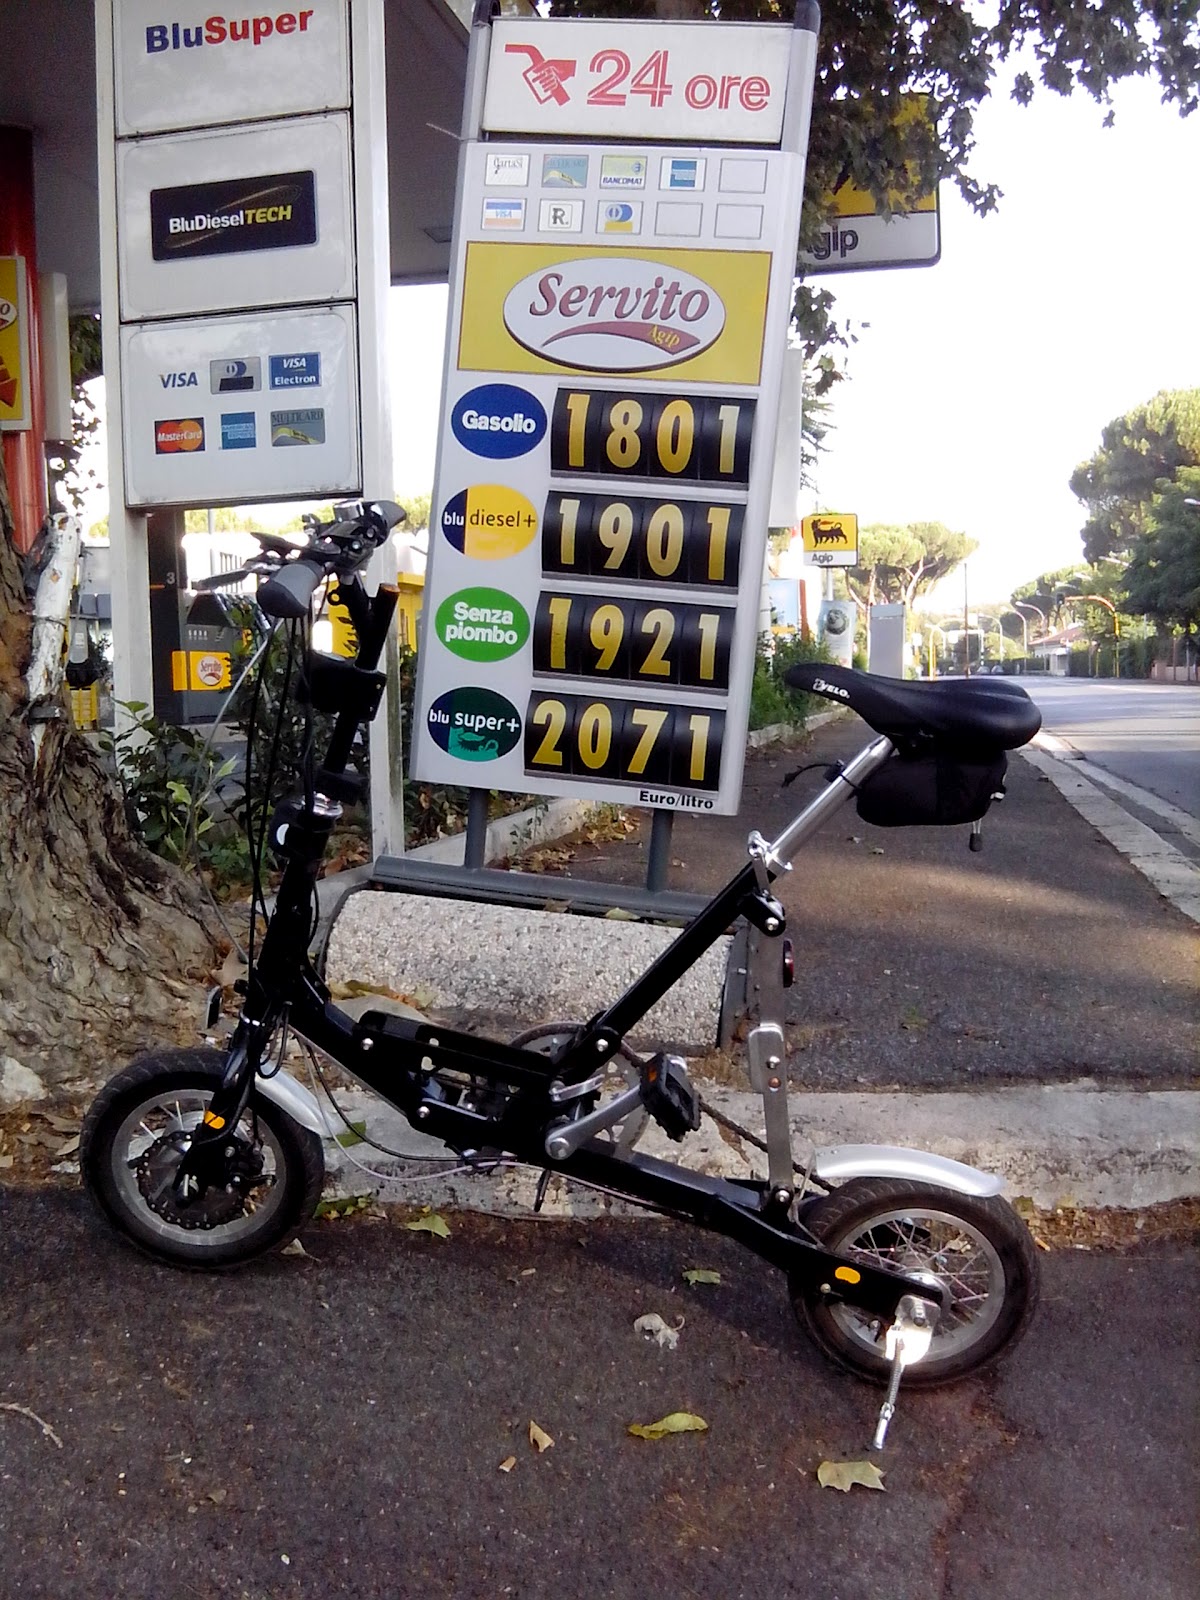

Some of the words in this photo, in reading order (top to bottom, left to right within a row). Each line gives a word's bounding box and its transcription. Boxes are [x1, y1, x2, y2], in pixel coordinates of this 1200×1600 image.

[146, 10, 314, 53] BluSuper
[587, 49, 672, 107] 24
[684, 73, 770, 111] ore
[603, 177, 643, 185] BANCOMAT
[495, 210, 512, 218] VISA
[529, 272, 710, 322] Servito
[649, 324, 681, 347] Agip
[283, 357, 306, 369] VISA
[160, 371, 198, 389] VISA
[274, 374, 316, 386] Electron
[157, 430, 202, 442] MasterCard
[462, 410, 536, 434] Gasolio
[567, 394, 740, 474] 1801
[443, 511, 465, 526] blu
[559, 499, 732, 581] 1901
[812, 553, 834, 563] Agip
[166, 572, 176, 584] 3
[445, 621, 518, 645] piombo
[453, 602, 514, 625] Senza
[549, 598, 720, 680] 1921
[429, 709, 450, 724] blu
[531, 700, 710, 781] 2071
[639, 791, 714, 810] Euro/litro
